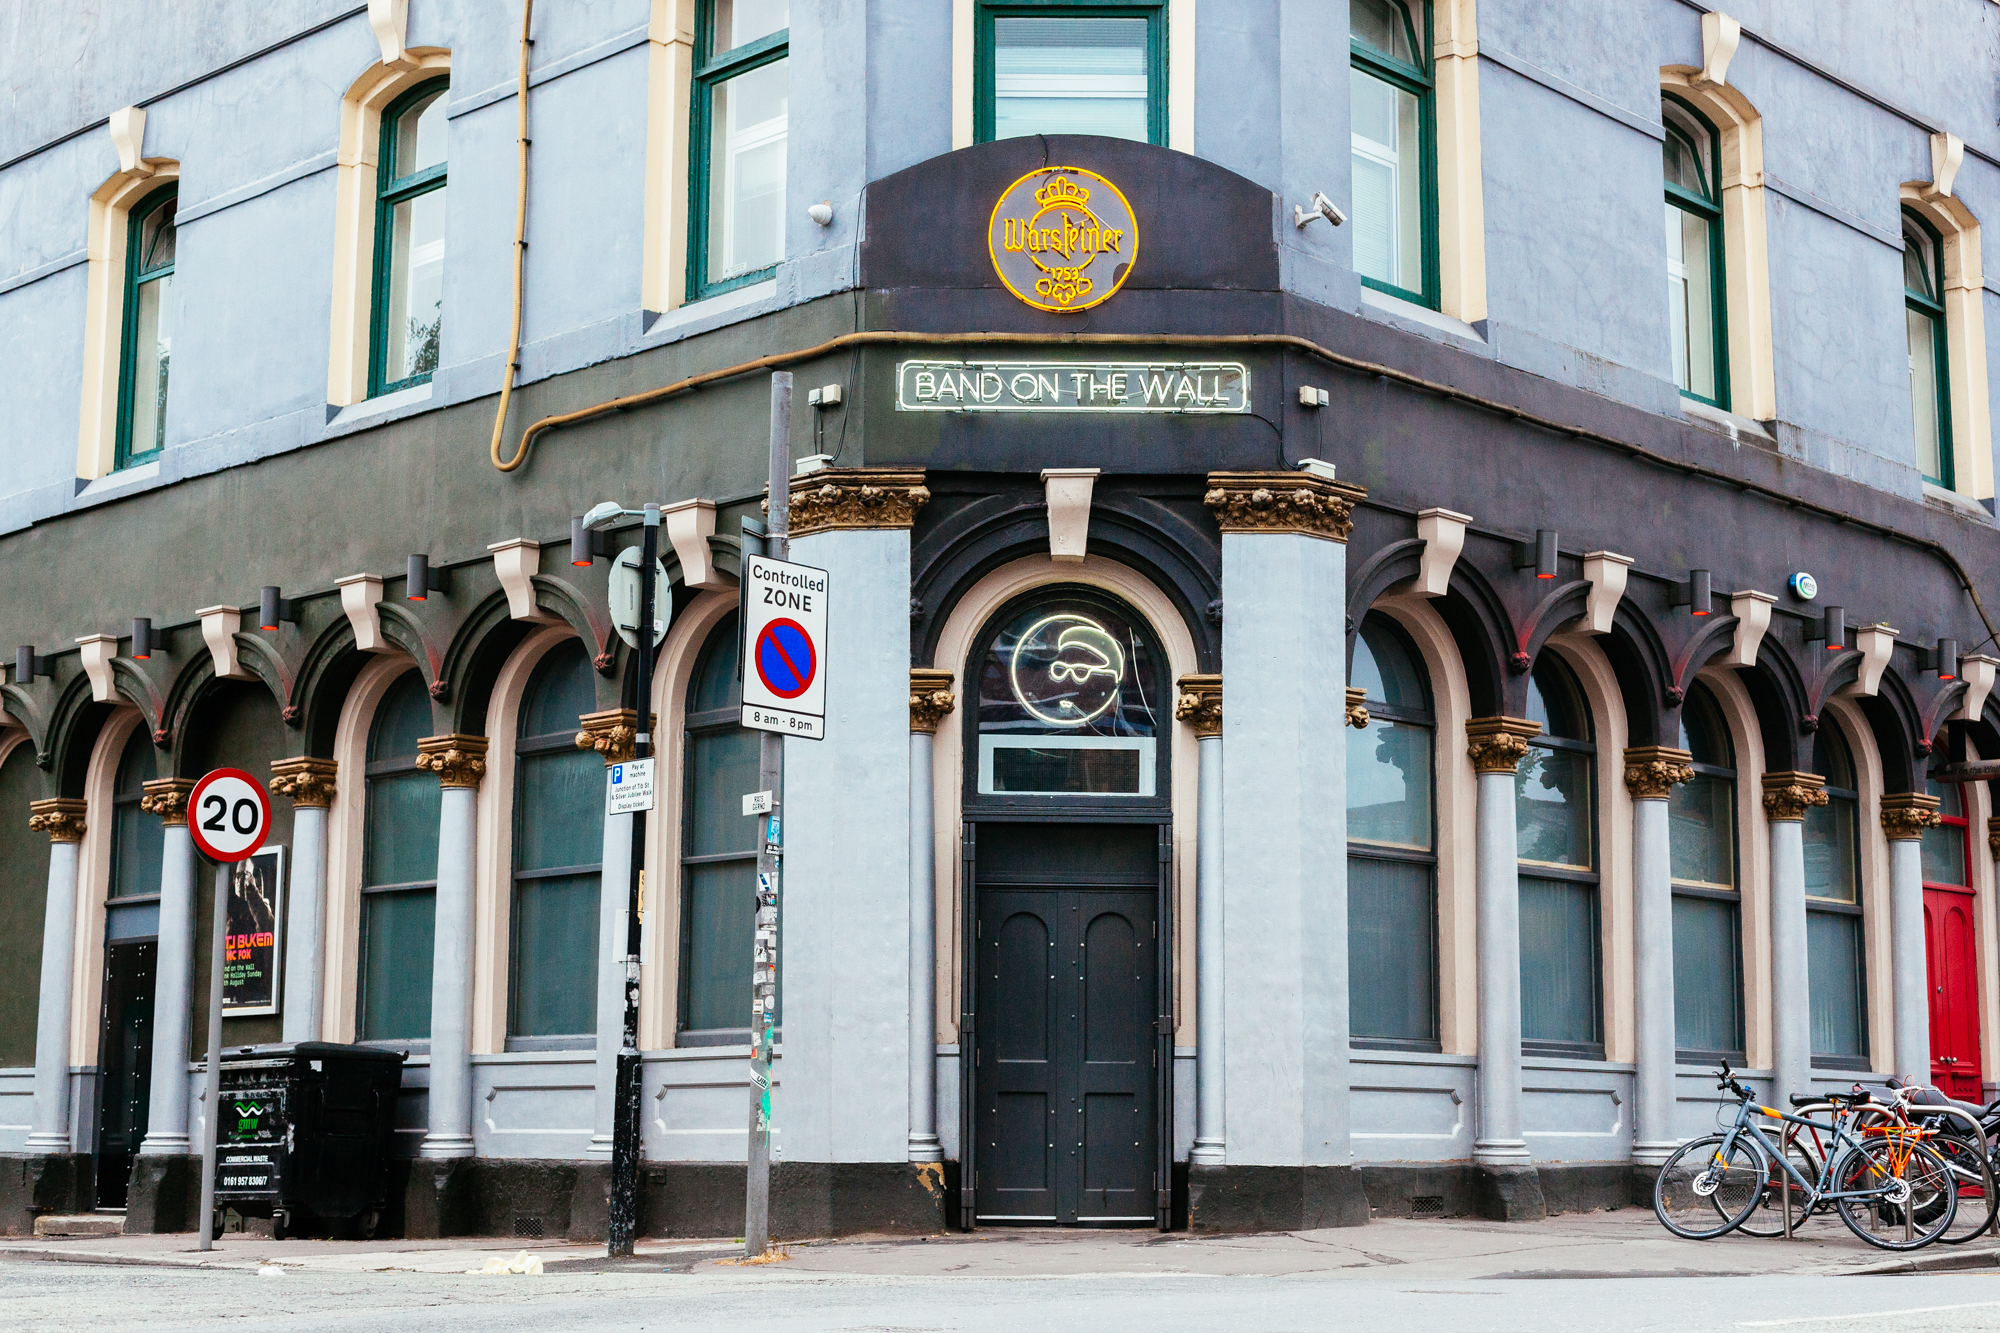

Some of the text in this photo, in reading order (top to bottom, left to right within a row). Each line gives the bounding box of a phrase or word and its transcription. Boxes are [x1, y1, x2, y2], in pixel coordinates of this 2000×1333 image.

[1003, 212, 1123, 261] Warsteiner
[1051, 267, 1079, 281] 1753
[916, 372, 1230, 404] BAND ON THE WALL
[753, 564, 824, 592] Controlled
[763, 587, 812, 612] ZONE
[754, 711, 760, 722] 8
[764, 715, 778, 725] am
[614, 768, 620, 782] P
[203, 794, 258, 834] 20
[225, 932, 273, 950] TJ BUKEM
[238, 948, 252, 960] FOX
[230, 979, 244, 987] August
[238, 1118, 258, 1133] gmw
[224, 1176, 237, 1186] 0161
[238, 1176, 248, 1186] 957
